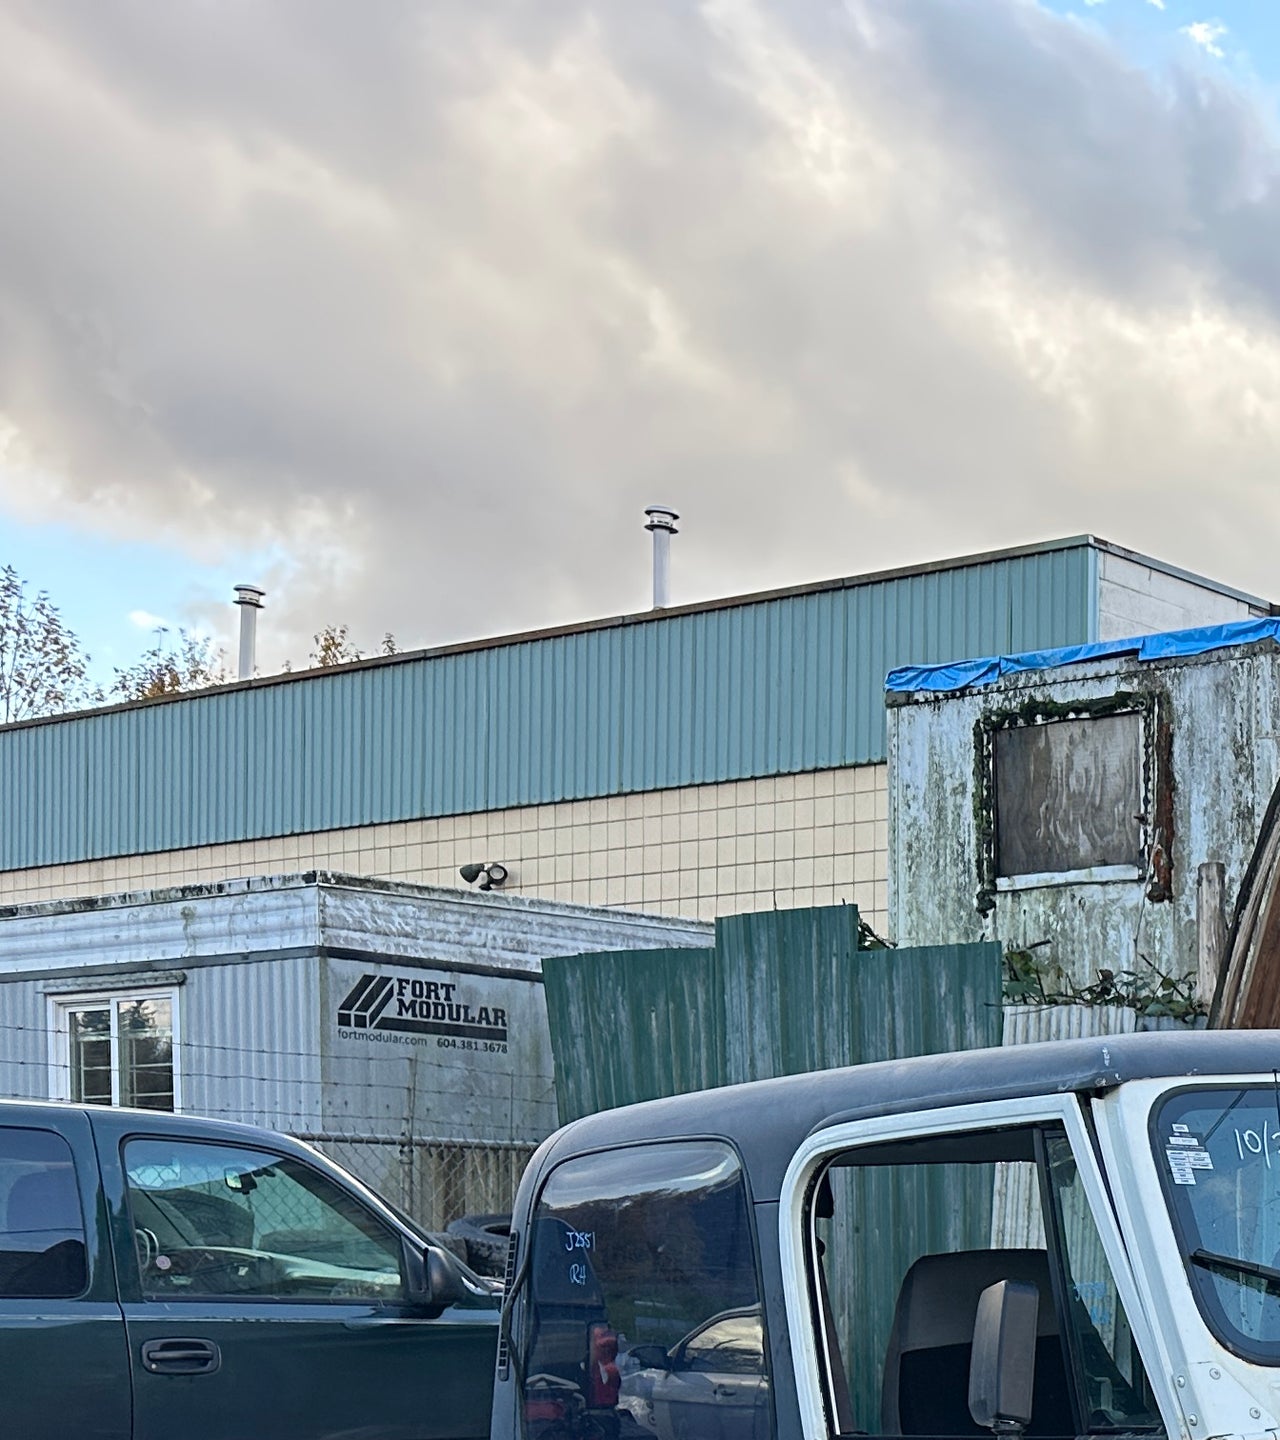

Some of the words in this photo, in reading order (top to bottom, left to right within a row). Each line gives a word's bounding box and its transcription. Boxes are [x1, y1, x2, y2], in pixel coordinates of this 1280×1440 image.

[396, 977, 456, 1002] FORT
[396, 998, 508, 1027] MODULAR
[337, 1029, 428, 1048] fortmodular.com
[436, 1037, 508, 1054] 604.381.3678
